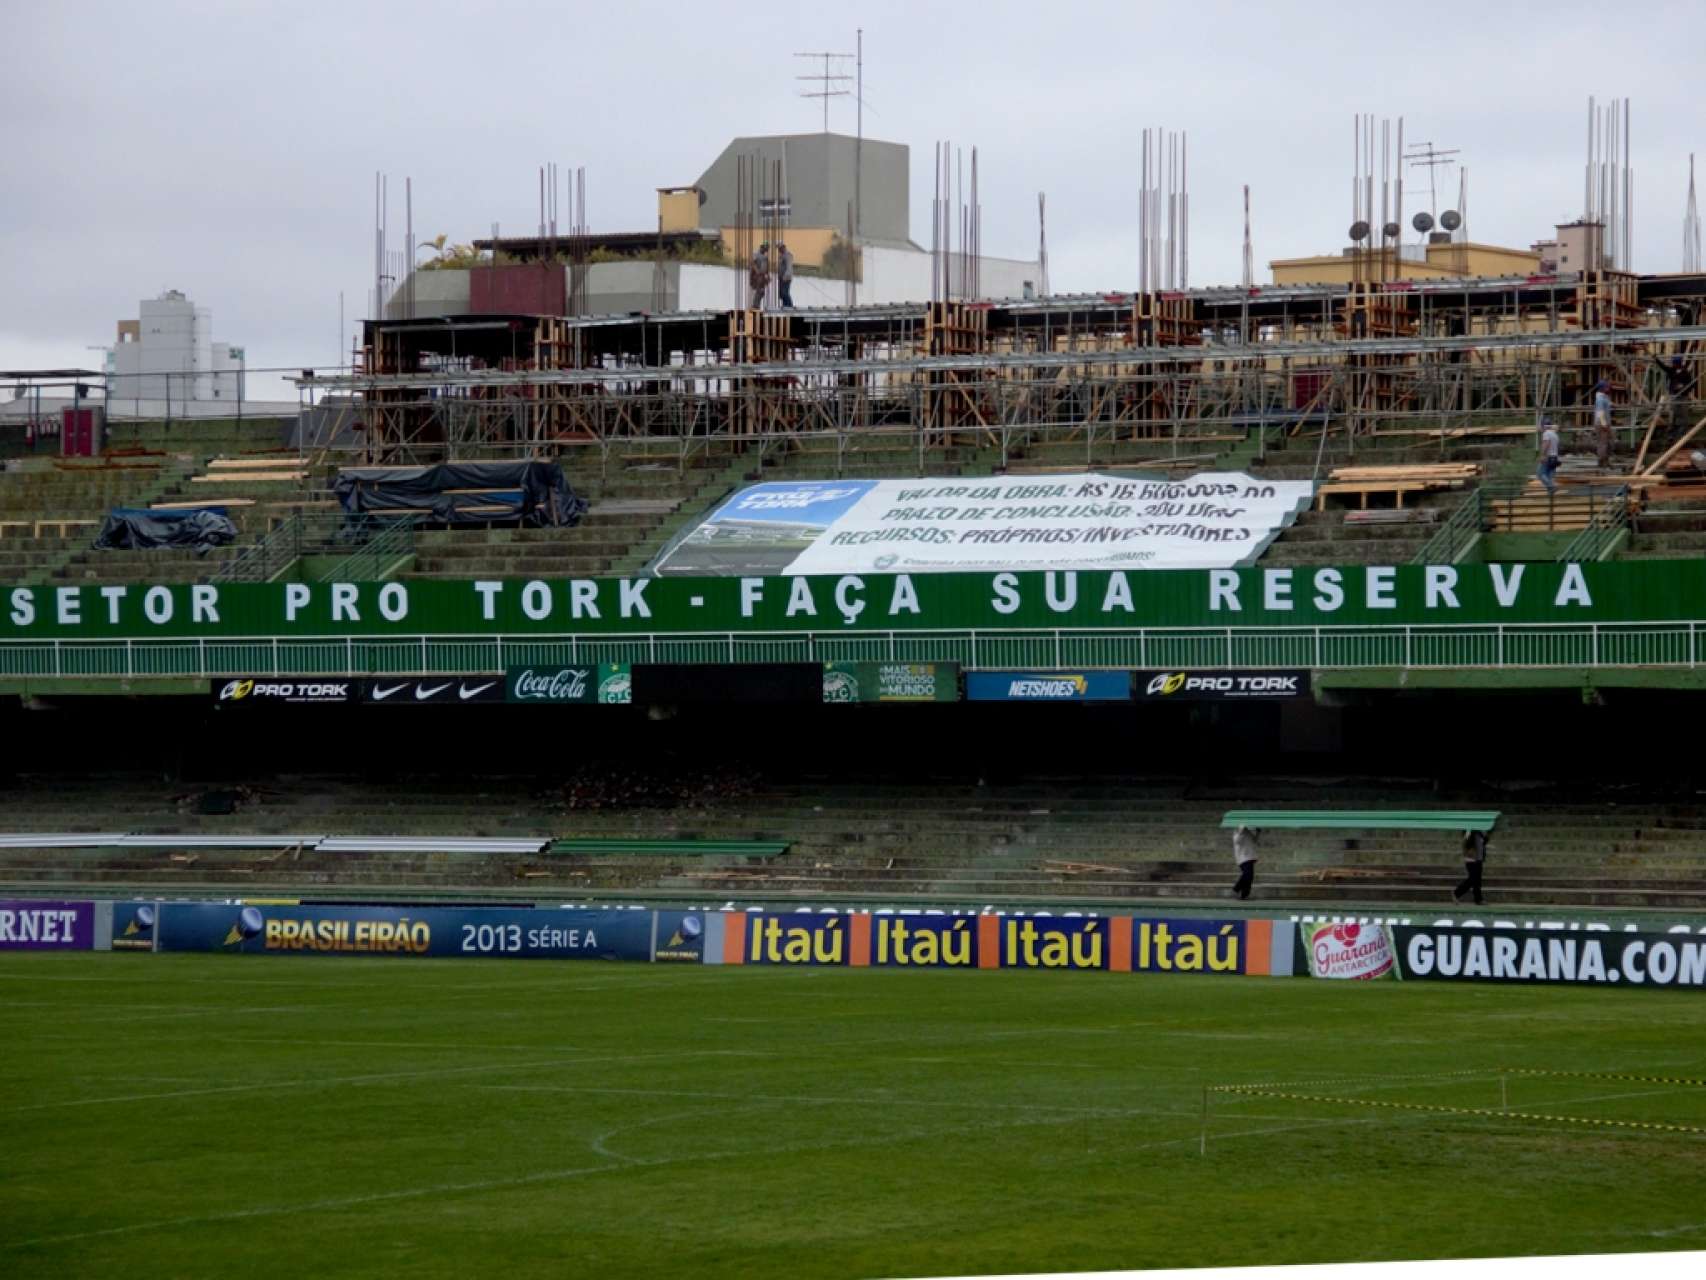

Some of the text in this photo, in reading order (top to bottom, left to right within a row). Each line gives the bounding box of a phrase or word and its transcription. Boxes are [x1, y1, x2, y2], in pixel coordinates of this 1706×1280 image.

[966, 486, 1000, 500] DA
[1003, 484, 1075, 499] OBRA:
[881, 507, 958, 521] PRAZO
[957, 506, 995, 521] DE
[831, 527, 957, 545] RECURSOS:
[10, 584, 220, 626] SETOR
[285, 582, 409, 622] PRO
[475, 579, 652, 620] TORK
[741, 574, 921, 624] FAÇA
[991, 570, 1136, 614] SUA
[1209, 563, 1593, 612] RESERVA
[253, 684, 349, 697] PRO TORK
[888, 684, 936, 696] MUNDO
[1008, 680, 1077, 697] NETSHOES
[1186, 676, 1298, 690] PRO TORK
[0, 909, 77, 943] RNET
[265, 917, 597, 952] BRASILEIRÃO 2013 SÉRIE A
[751, 917, 843, 963] Itaú
[877, 919, 971, 965] Itaú
[1006, 920, 1101, 967] Itaú
[1138, 923, 1238, 971] Itaú
[1407, 933, 1706, 984] GUARANA.COM
